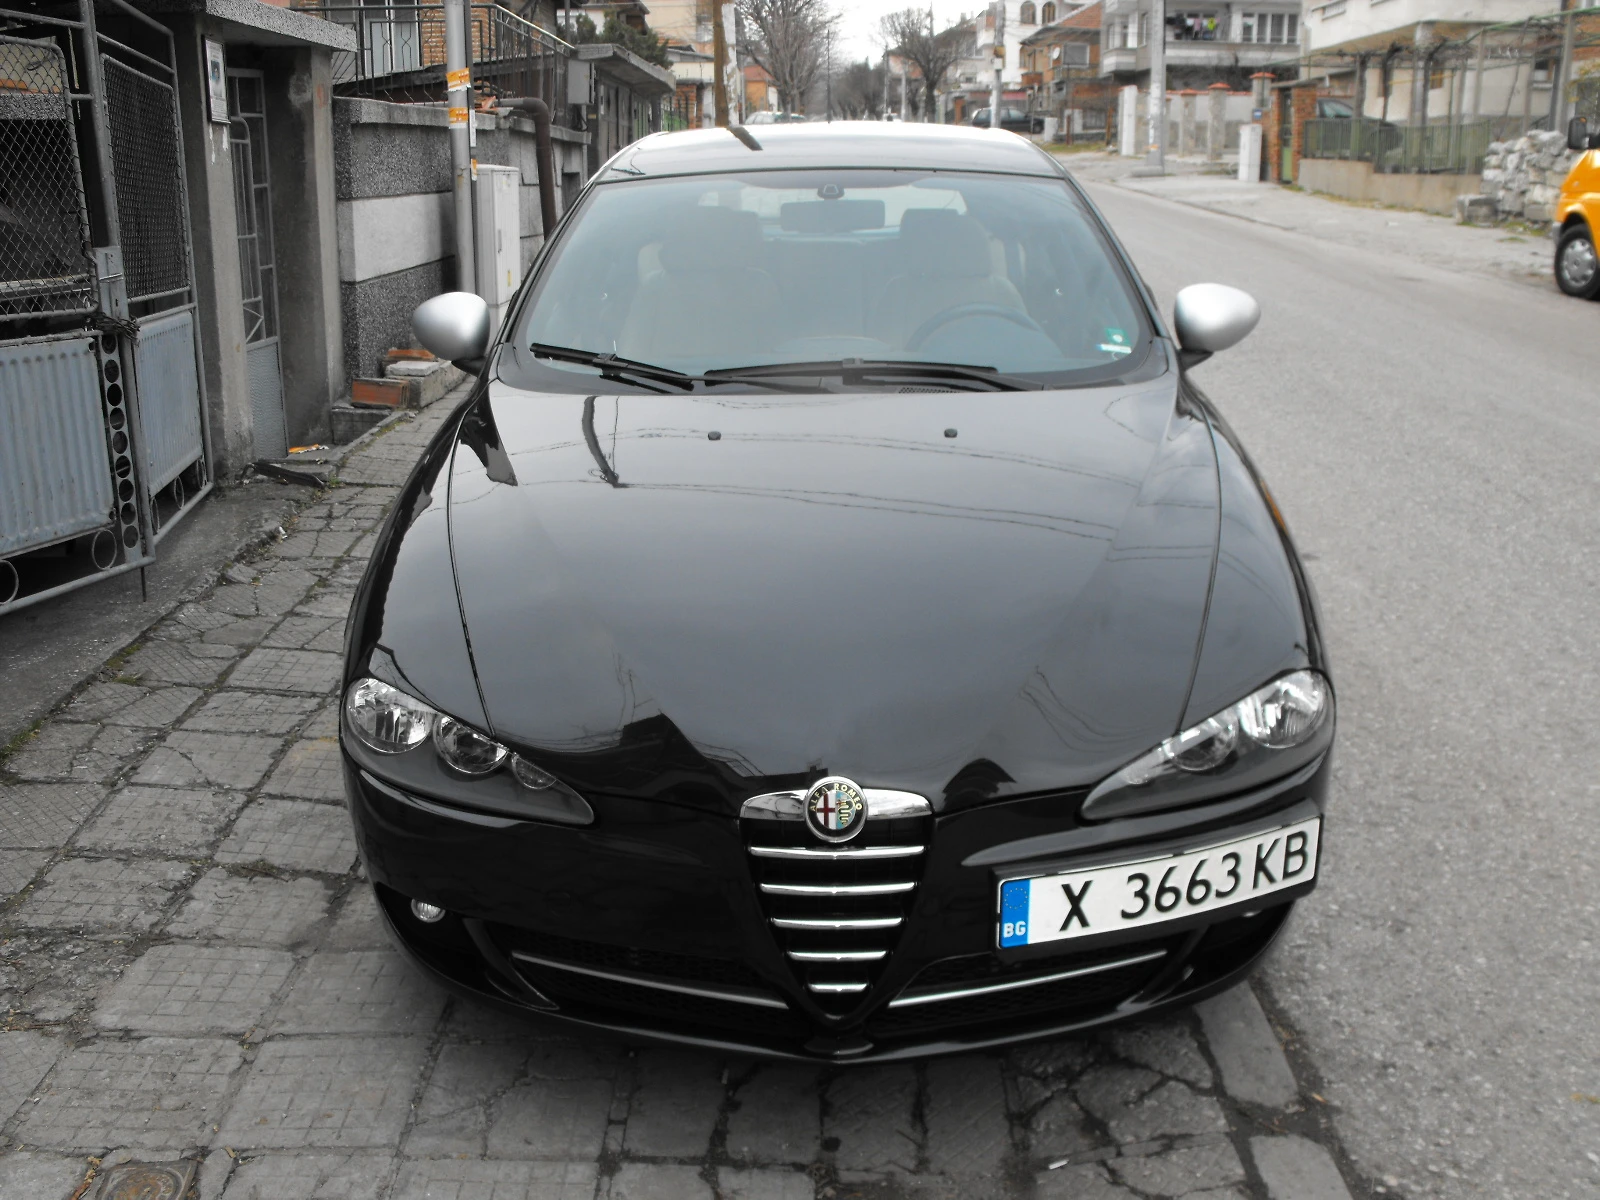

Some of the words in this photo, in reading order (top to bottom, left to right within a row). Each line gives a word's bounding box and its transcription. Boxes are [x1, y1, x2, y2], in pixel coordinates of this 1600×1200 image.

[809, 786, 828, 812] ALFA
[834, 783, 863, 811] ROMEO
[1059, 880, 1094, 932] X
[1003, 921, 1027, 938] BG
